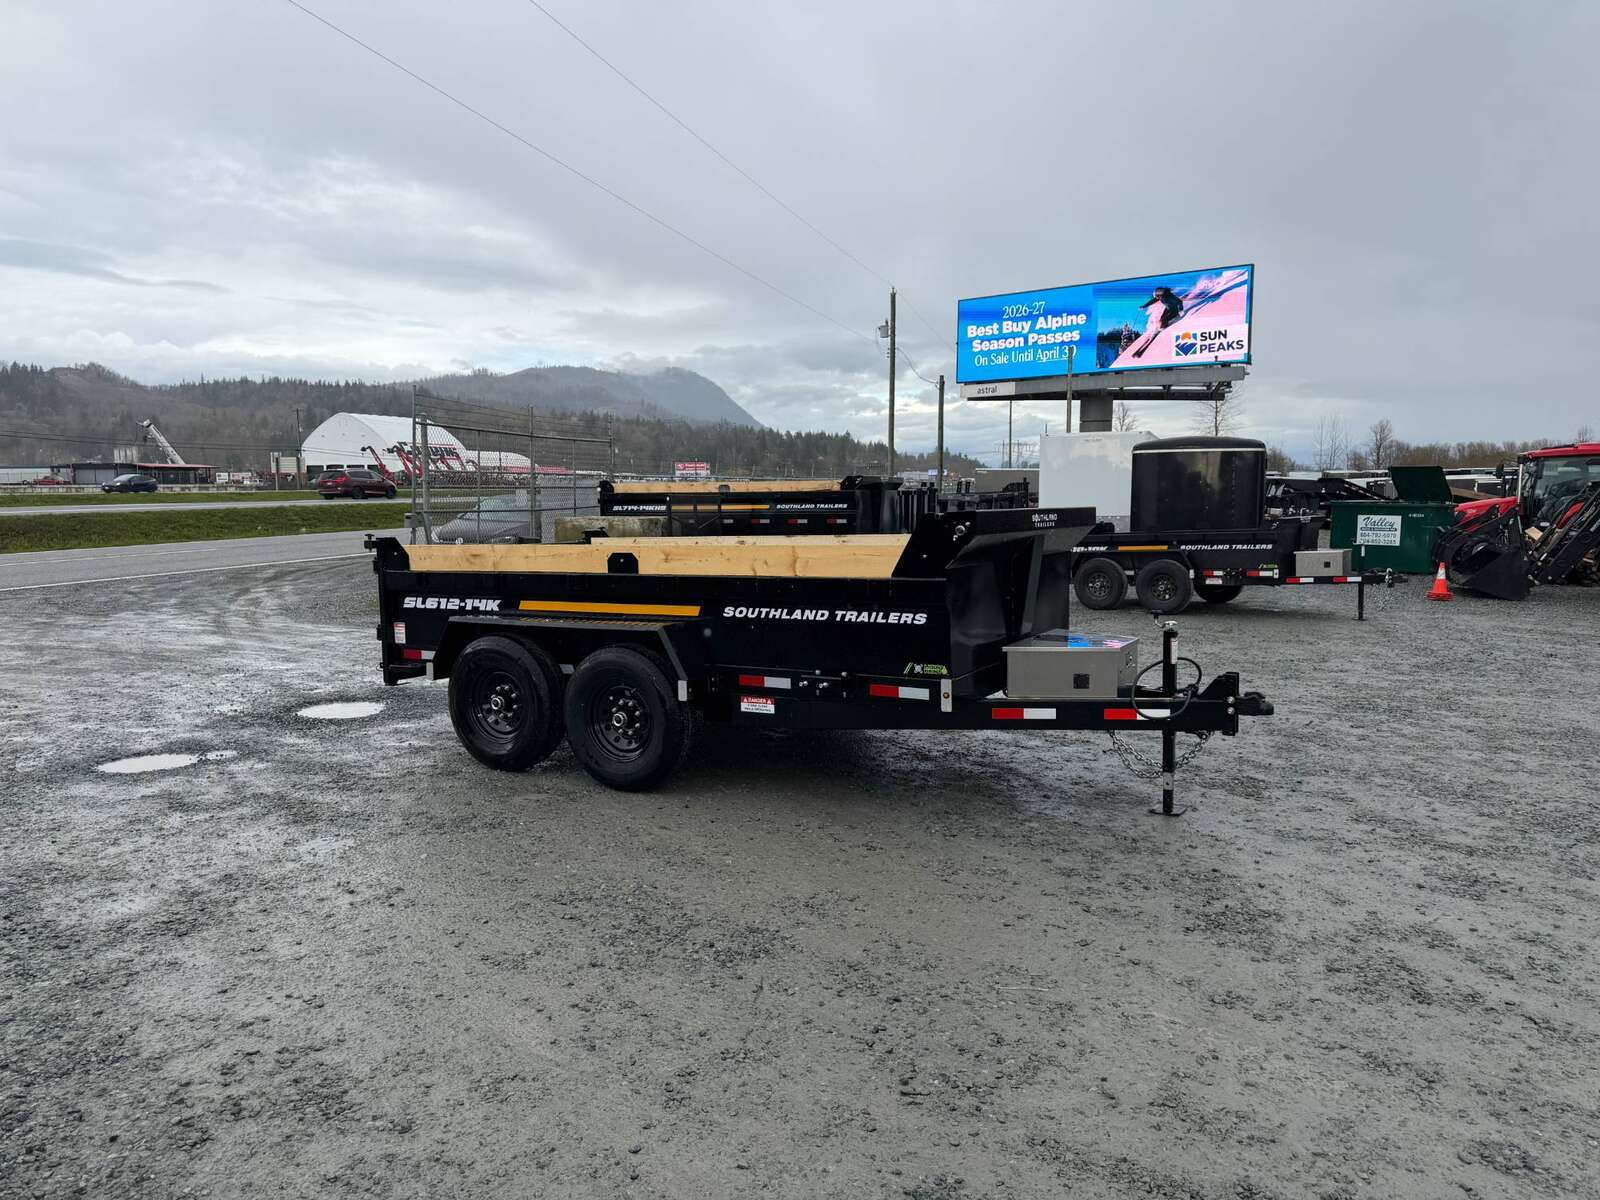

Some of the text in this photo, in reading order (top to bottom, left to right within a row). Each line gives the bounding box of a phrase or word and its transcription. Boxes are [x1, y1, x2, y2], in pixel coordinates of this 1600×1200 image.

[1003, 301, 1045, 319] 2026-27
[967, 313, 1087, 338] Best Buy Alpine
[972, 330, 1080, 352] Season Passes
[1200, 329, 1227, 342] SUN
[1200, 339, 1244, 354] PEAKS
[974, 354, 988, 367] On
[990, 351, 1009, 365] Sale
[1012, 348, 1034, 363] Until
[1036, 346, 1060, 363] April
[976, 385, 998, 395] astral
[1363, 516, 1396, 529] Valley
[403, 596, 501, 611] SL612-14K
[723, 606, 928, 625] SOUTHLAND TRAILERS
